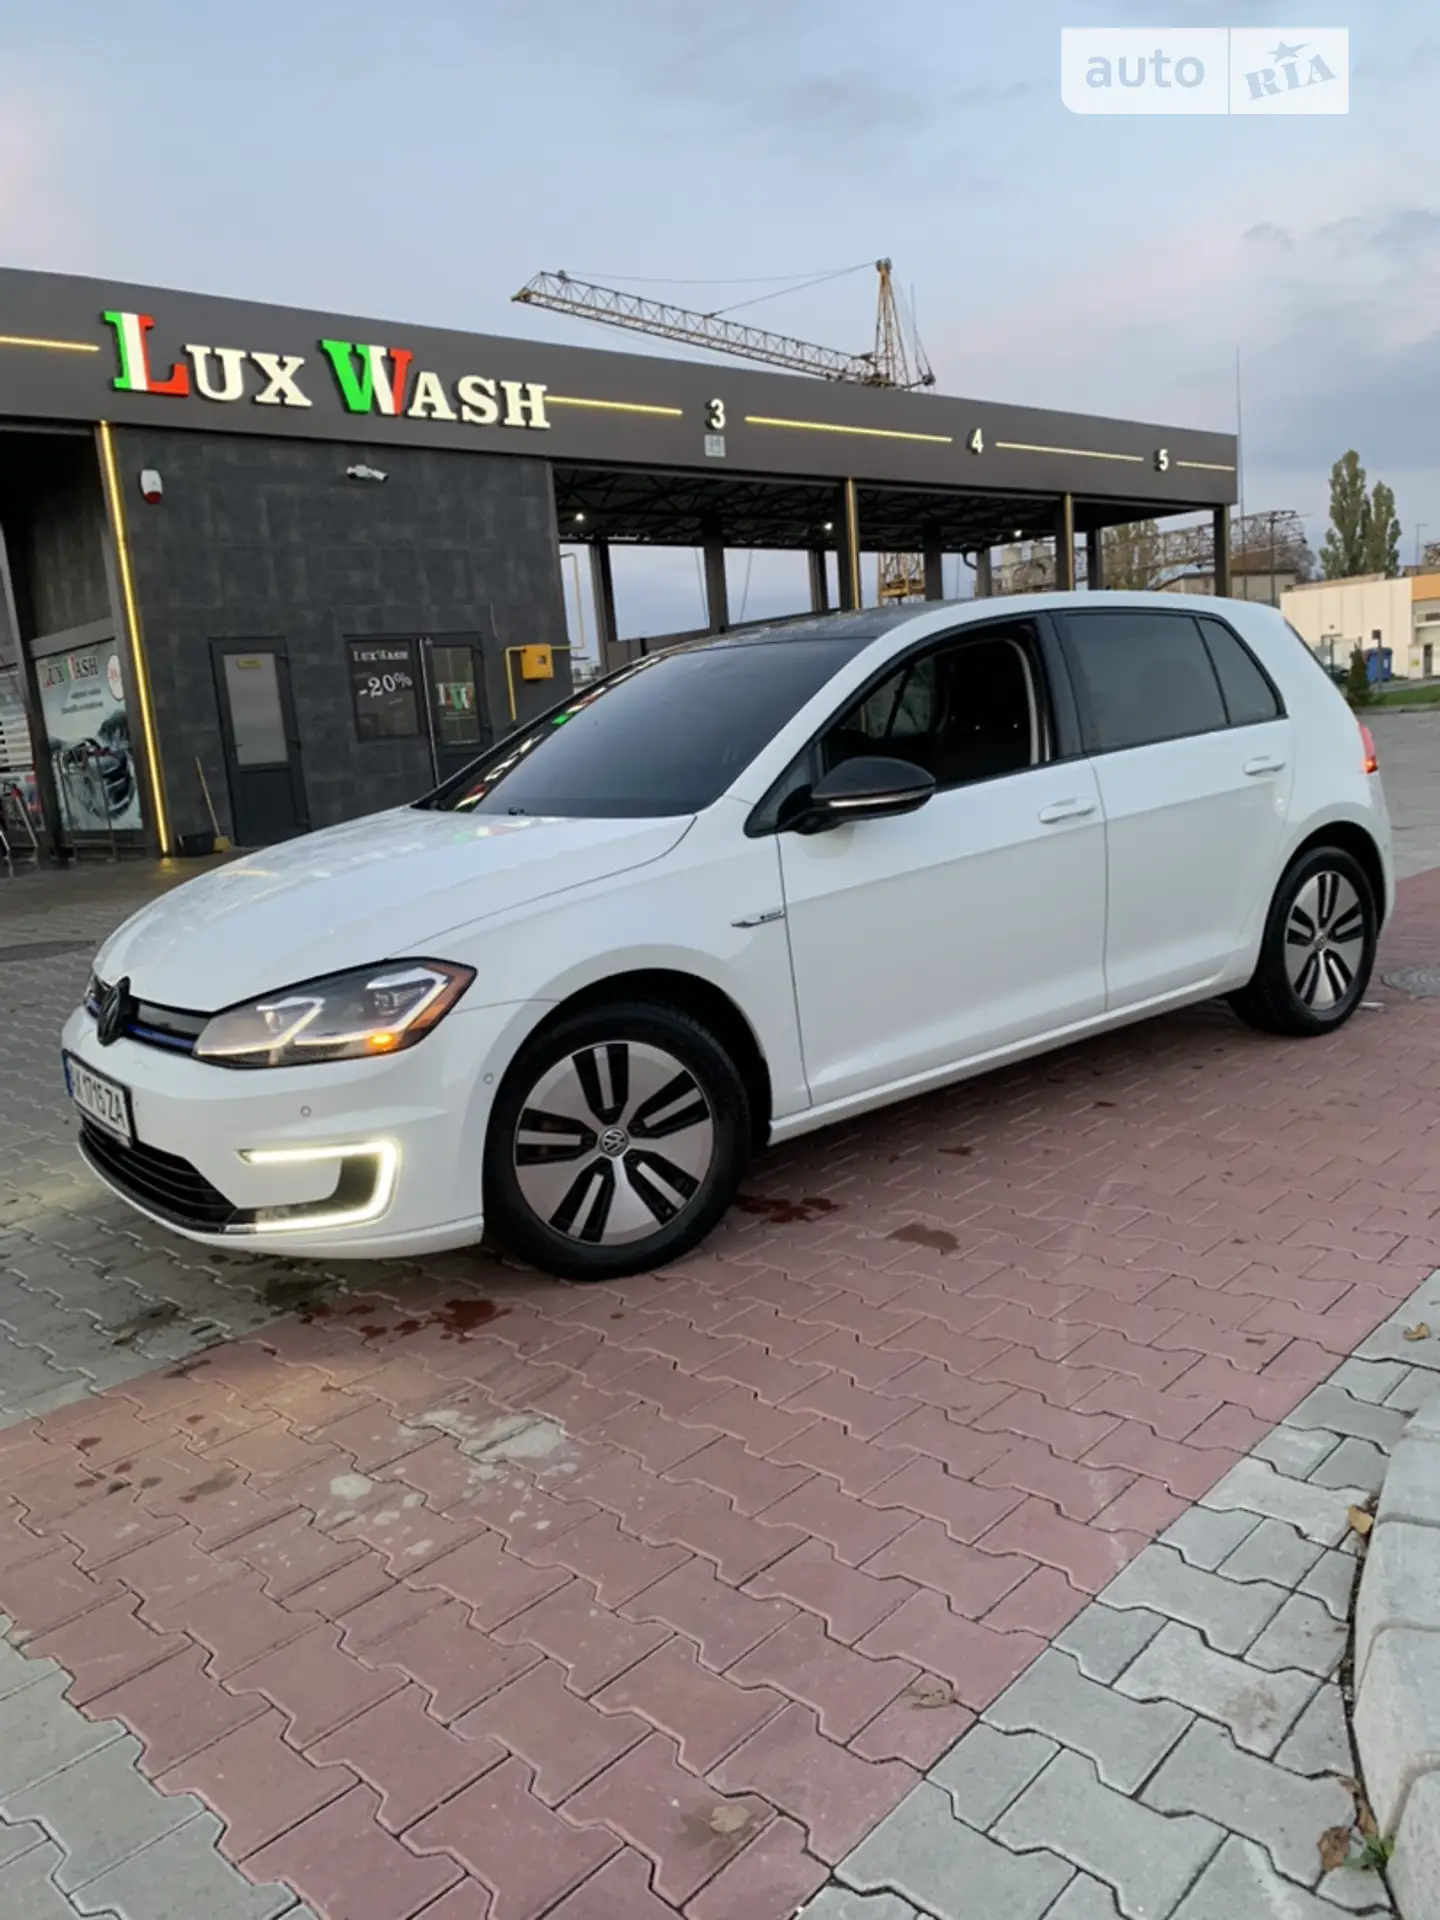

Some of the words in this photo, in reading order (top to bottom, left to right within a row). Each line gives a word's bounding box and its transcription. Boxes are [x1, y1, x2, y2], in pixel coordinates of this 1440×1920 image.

[104, 310, 312, 408] LUX
[321, 339, 550, 429] WASH
[708, 398, 726, 430] 3
[970, 428, 984, 454] 4
[1157, 449, 1170, 472] 5
[359, 671, 413, 699] -20%
